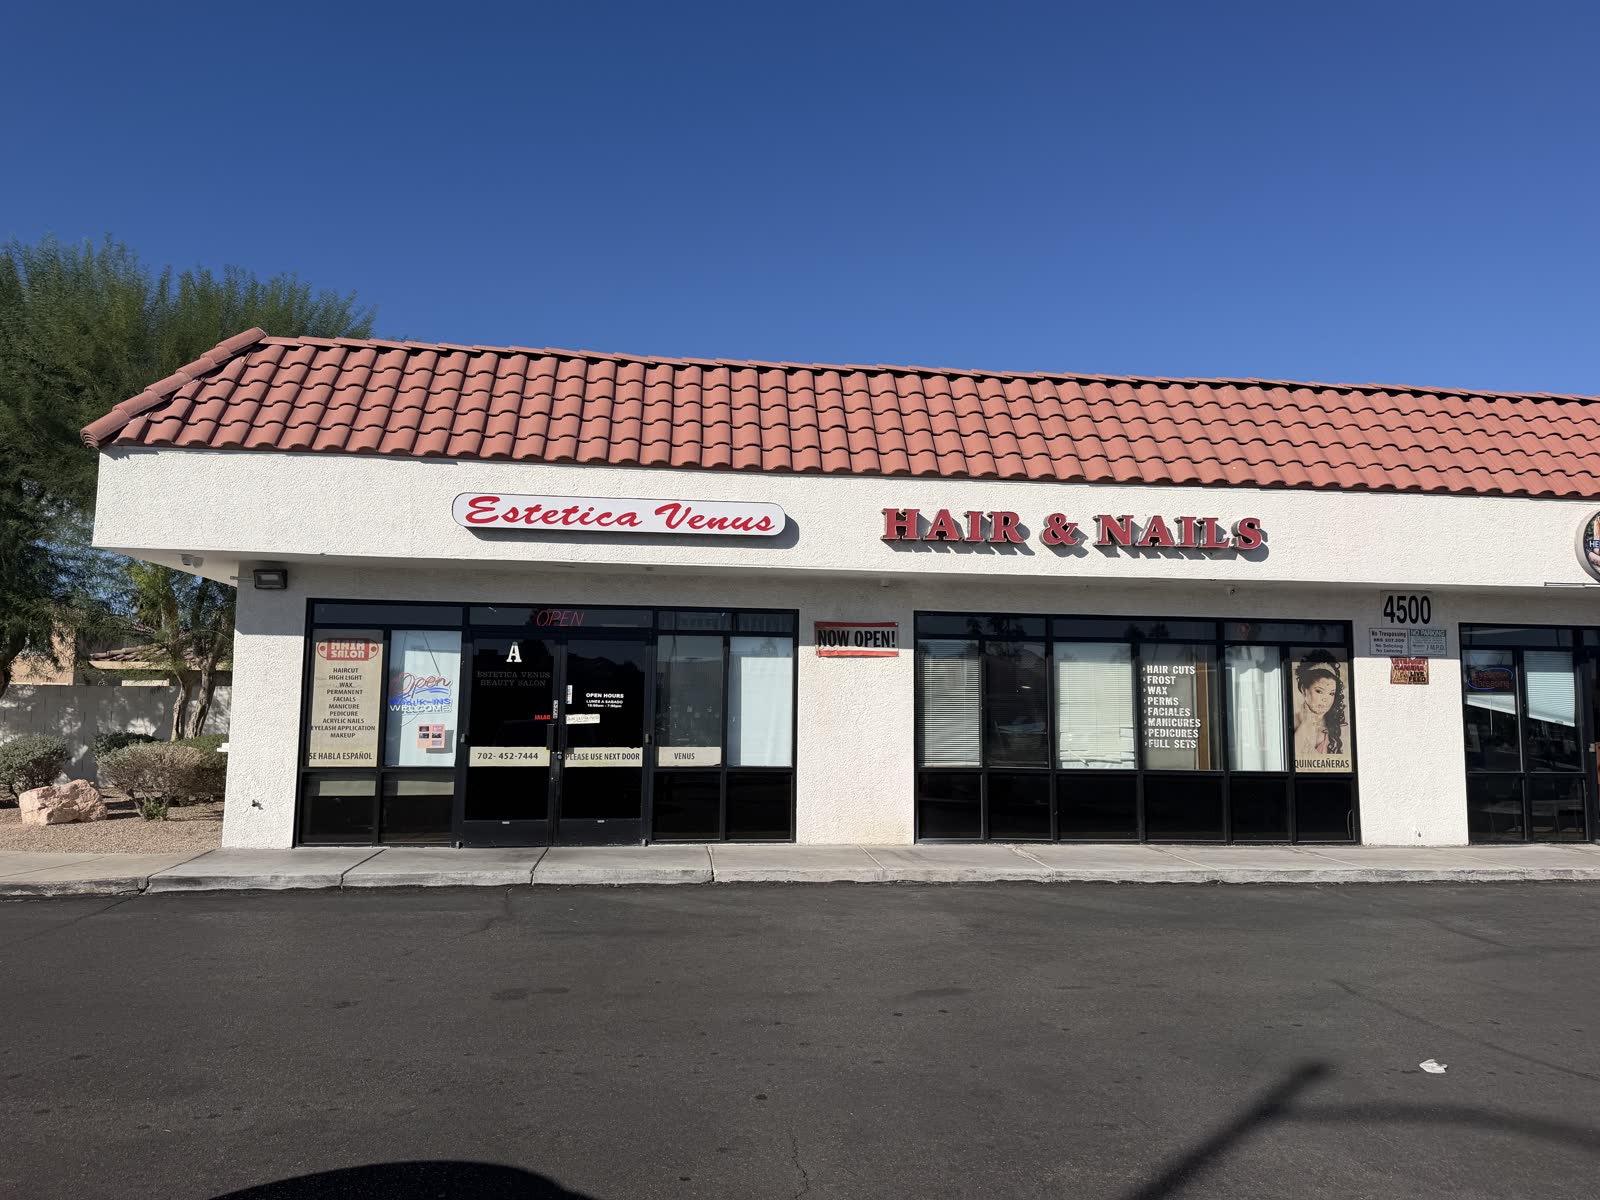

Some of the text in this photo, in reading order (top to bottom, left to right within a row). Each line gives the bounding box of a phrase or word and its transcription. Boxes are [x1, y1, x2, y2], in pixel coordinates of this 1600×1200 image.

[465, 495, 776, 532] Estetica Venus
[881, 508, 1262, 551] HAIR & NAILS
[1383, 595, 1432, 624] 4500
[536, 610, 585, 627] OPEN
[817, 629, 897, 648] NOW OPEN!
[1379, 630, 1406, 638] Trespassing
[331, 650, 365, 659] SALON
[506, 642, 522, 663] A
[332, 667, 359, 676] HAIRCUT
[1146, 665, 1196, 675] HAIR CUTS
[477, 671, 551, 680] ESTETICA VENUS
[1147, 675, 1176, 685] FROST
[390, 672, 452, 699] Open
[480, 679, 546, 688] BEAUTY SALON
[1147, 686, 1168, 695] WAX
[1147, 696, 1179, 706] PERMS
[1147, 707, 1191, 717] FACIALES
[1147, 717, 1201, 728] MANICURES
[1148, 728, 1199, 738] PEDICURES
[1148, 738, 1197, 749] FULL SETS
[309, 750, 373, 760] SE HABLA ESPAÑOL
[498, 752, 539, 760] 452-7444
[565, 752, 640, 761] PLEASE USE NEXT DOOR
[1295, 758, 1350, 769] QUINCEAÑERAS
